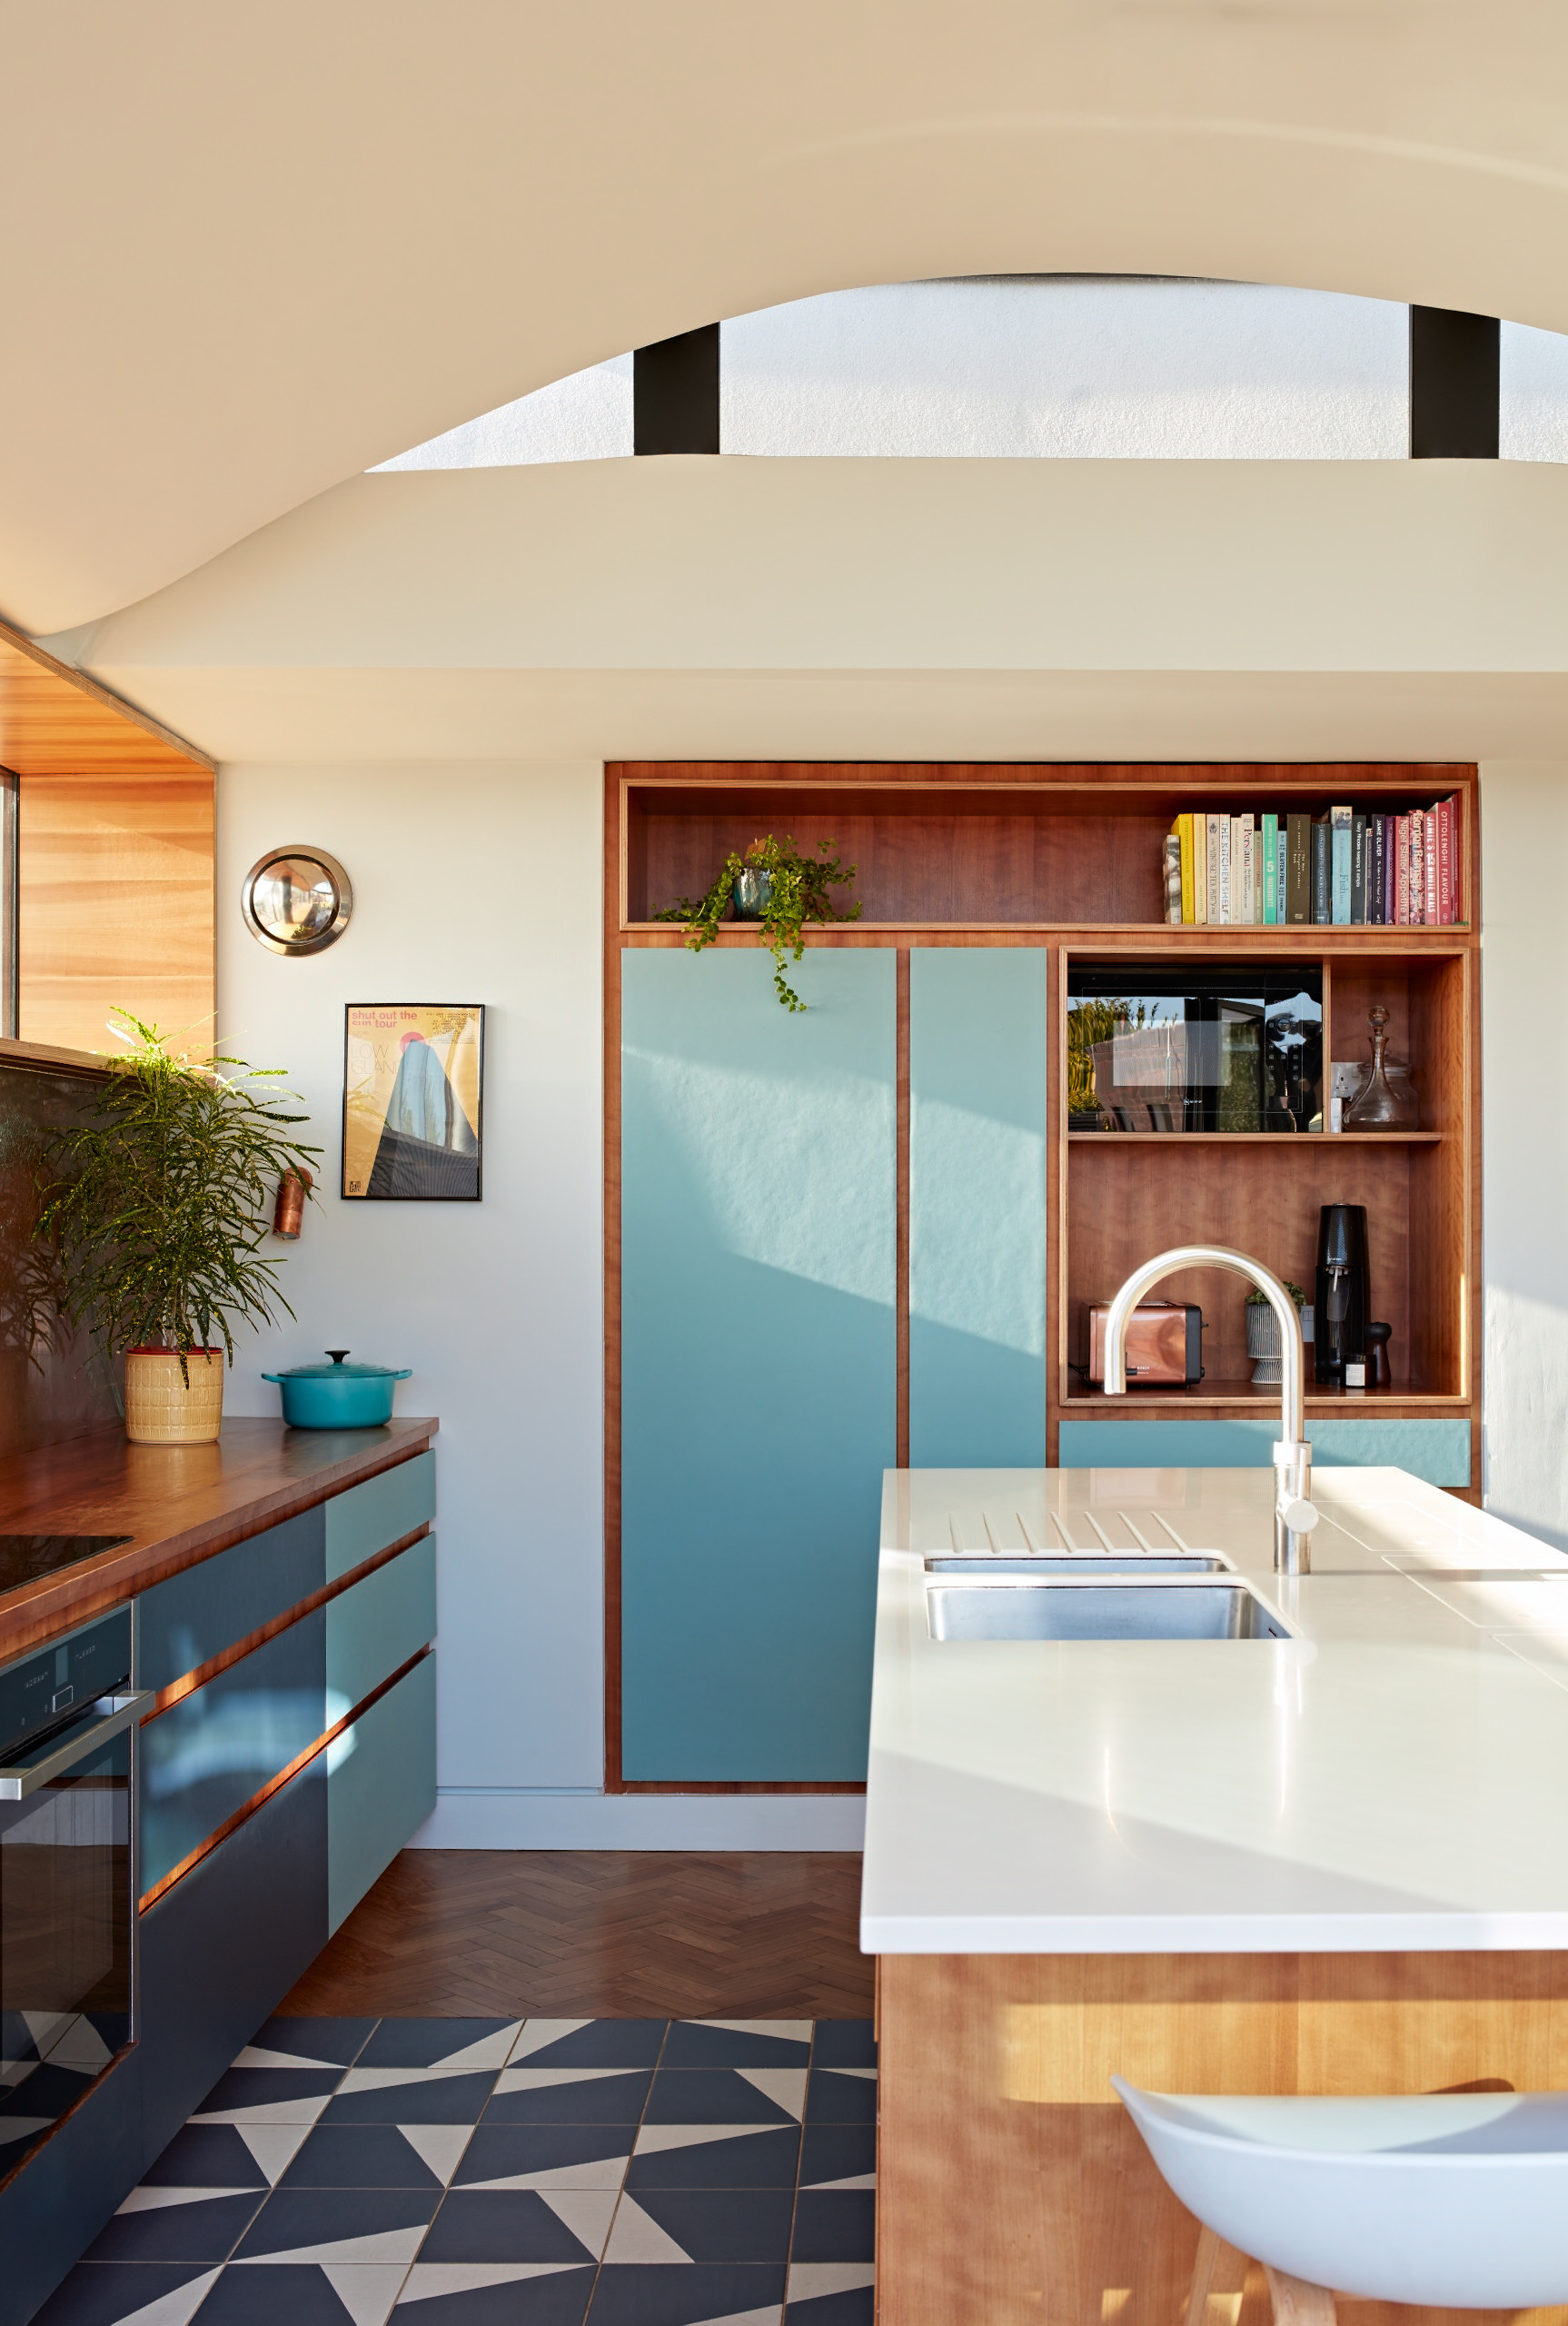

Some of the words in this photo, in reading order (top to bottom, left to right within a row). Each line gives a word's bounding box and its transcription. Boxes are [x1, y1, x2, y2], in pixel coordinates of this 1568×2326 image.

[1221, 822, 1229, 840] THE
[1400, 820, 1408, 843] Nigel
[1413, 811, 1423, 849] Gordon
[1427, 817, 1435, 850] JAMIE'S
[1244, 829, 1253, 867] Persiana
[1400, 844, 1408, 871] Slater
[1221, 842, 1229, 884] KITCHEN
[1266, 860, 1275, 872] 5
[1413, 850, 1423, 890] Ramsay
[1339, 874, 1349, 894] Fish
[1427, 867, 1435, 890] MINUTE
[1221, 886, 1229, 914] SHELF
[1400, 873, 1408, 913] Appetite
[1427, 892, 1435, 913] MEALS
[352, 1010, 376, 1019] shut
[379, 1011, 397, 1019] out
[400, 1010, 418, 1020] the
[375, 1019, 398, 1029] tour
[351, 1043, 389, 1059] LOW
